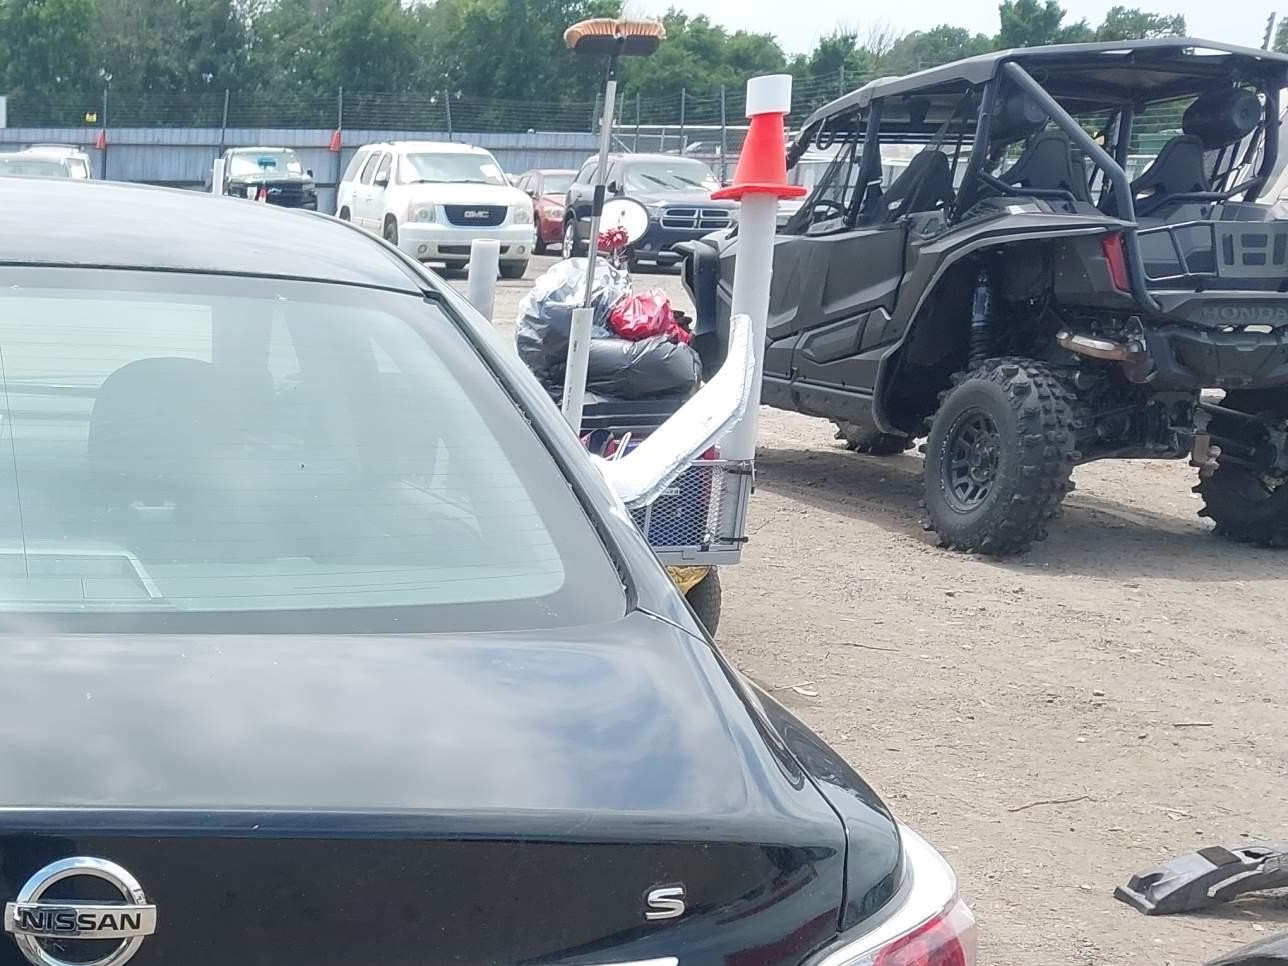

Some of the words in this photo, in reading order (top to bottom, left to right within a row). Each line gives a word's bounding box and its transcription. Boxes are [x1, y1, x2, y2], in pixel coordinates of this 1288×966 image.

[464, 210, 489, 218] GMC
[1201, 306, 1288, 320] HONDA
[645, 886, 686, 921] S
[22, 911, 141, 931] NISSAN
